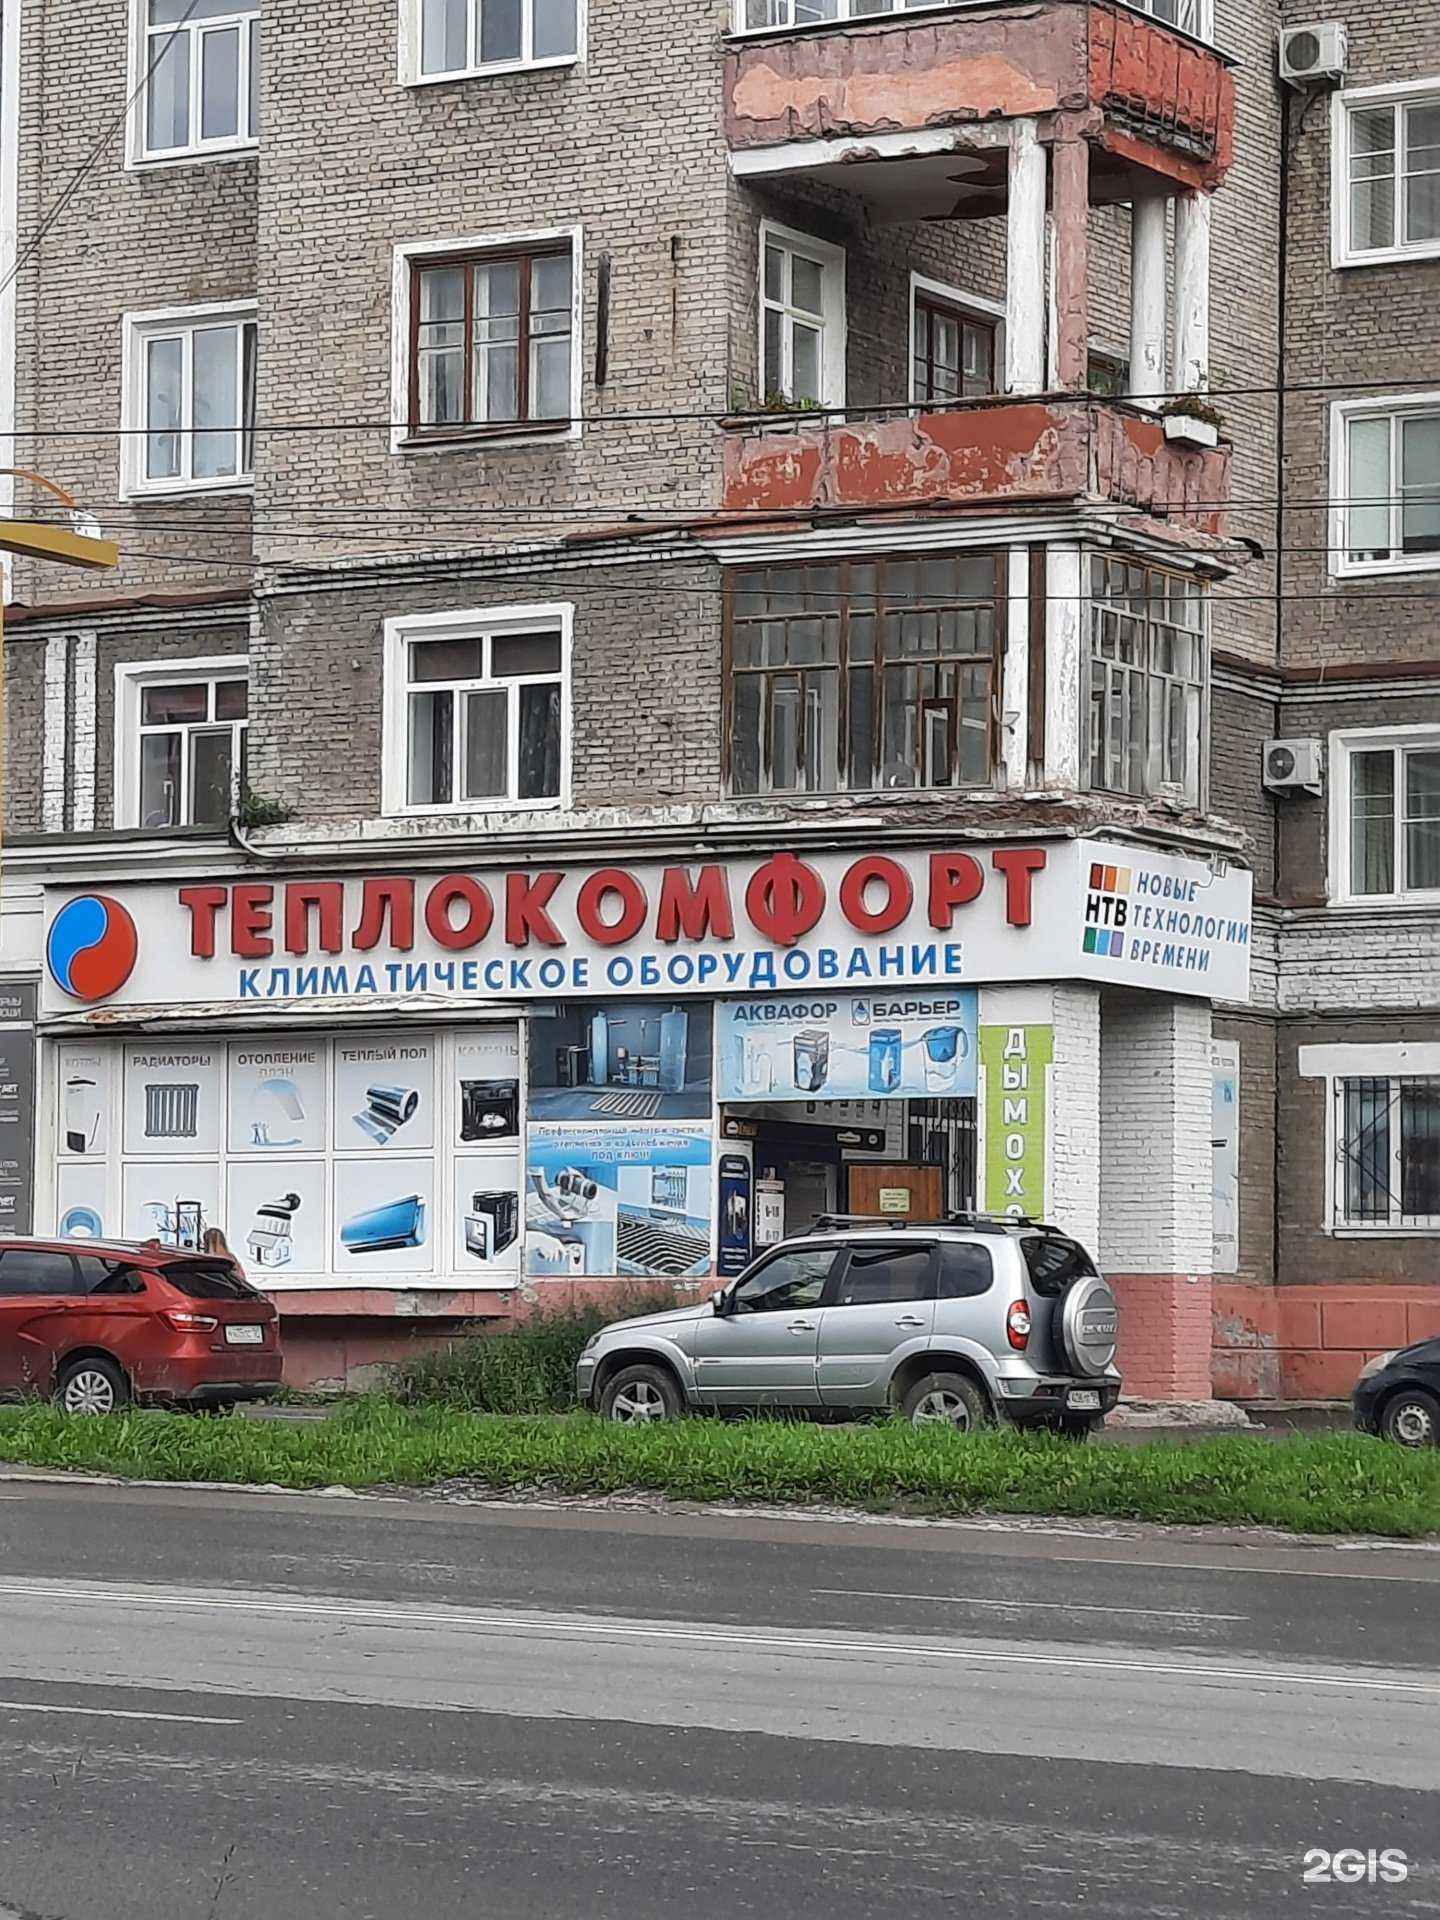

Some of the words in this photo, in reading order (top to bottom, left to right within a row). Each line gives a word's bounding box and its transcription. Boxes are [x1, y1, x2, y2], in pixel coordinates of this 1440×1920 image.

[1136, 871, 1200, 902] НОВЫЕ
[179, 848, 1047, 959] ТЕПЛОКОМФОРТ
[1085, 894, 1128, 927] НТВ
[1132, 904, 1249, 945] ТЕХНОЛОГИИ
[239, 957, 589, 998] КЛИМАТИЧЕСКОЕ
[606, 943, 963, 988] ОБОРУДОВАНИЕ
[1130, 938, 1211, 972] ВРЕМЕНИ
[732, 1001, 838, 1021] АКВАФОР
[872, 999, 961, 1017] БАРЬЕР
[132, 1055, 211, 1068] РАДИАТОРЫ
[237, 1051, 316, 1066] ОТОПЛЕНИЕ
[341, 1048, 396, 1062] ТЕПЛЫЙ
[399, 1047, 427, 1060] ПОЛ
